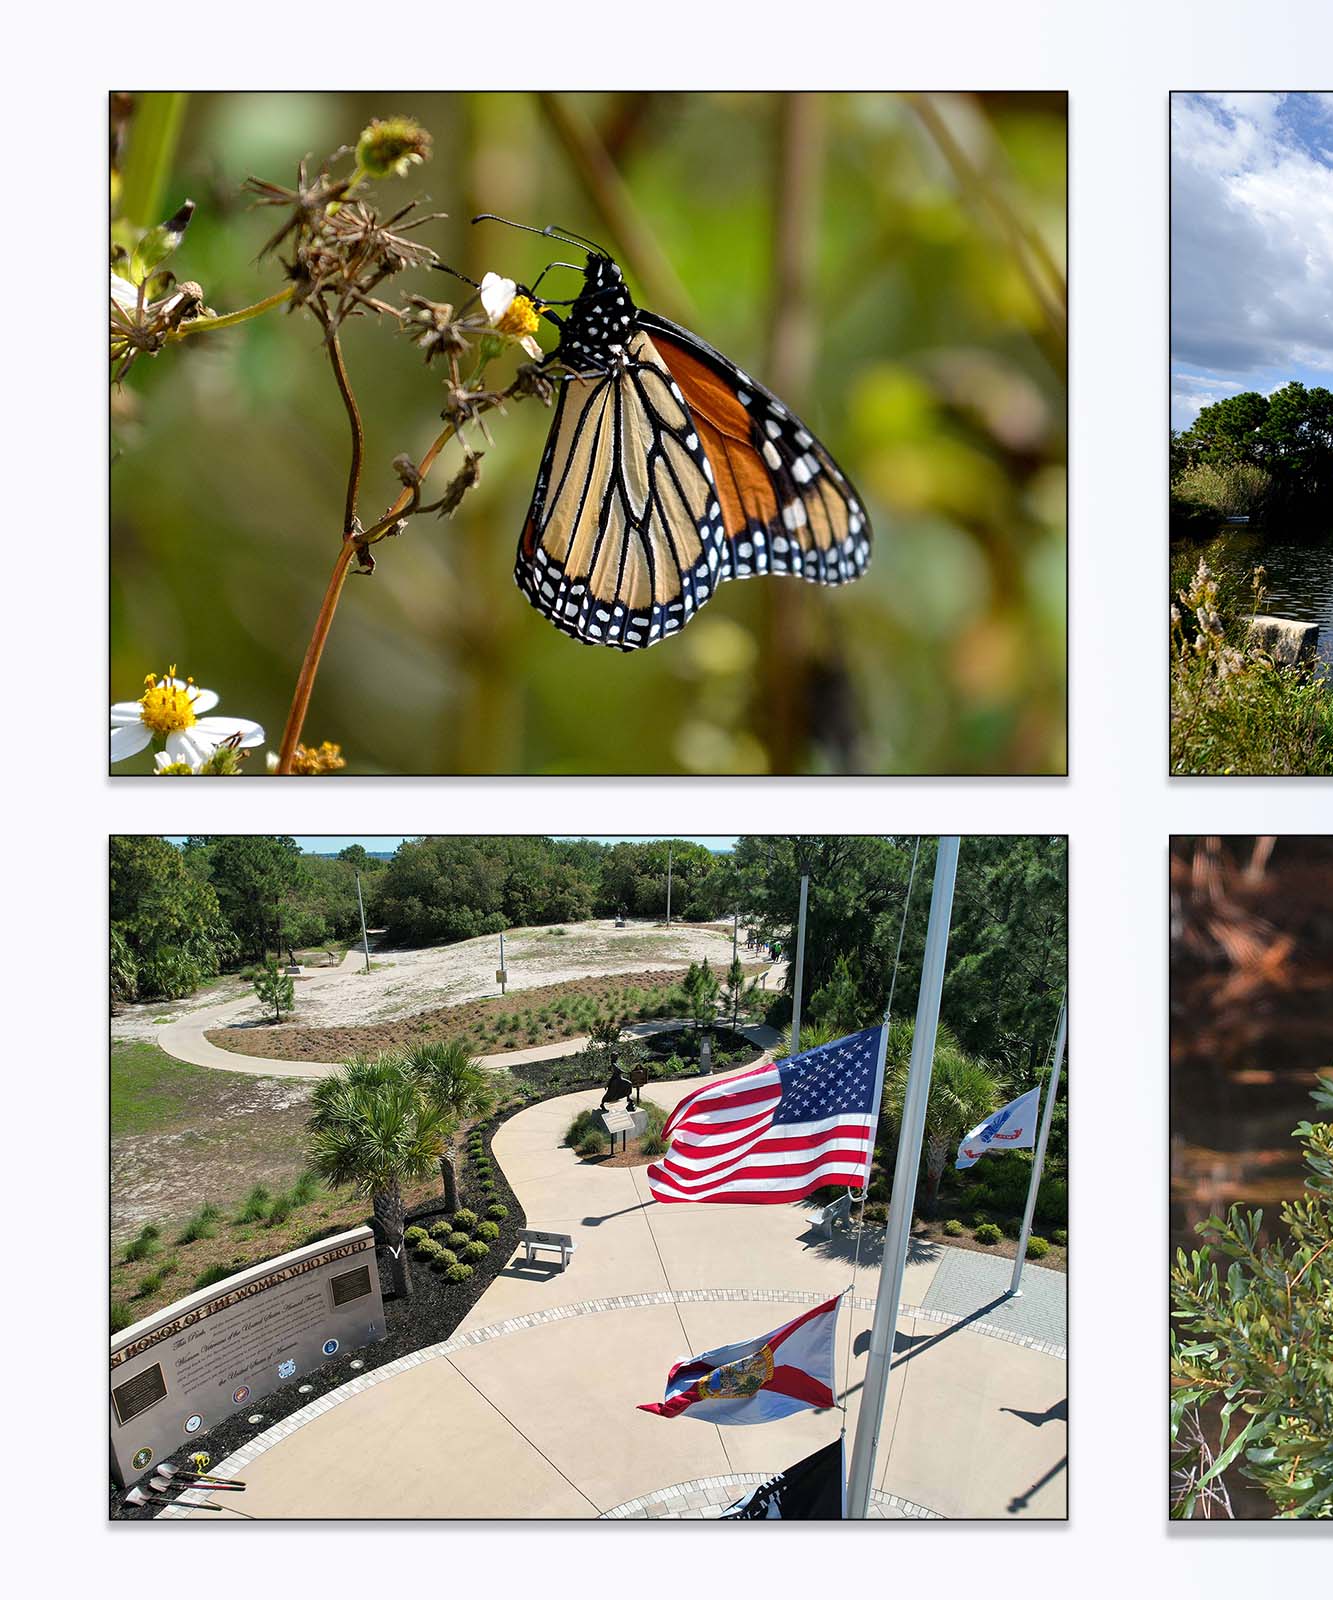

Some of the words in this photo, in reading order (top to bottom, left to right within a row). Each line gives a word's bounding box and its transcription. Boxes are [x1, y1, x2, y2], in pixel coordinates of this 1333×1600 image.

[126, 1320, 183, 1358] HONOR
[185, 1311, 206, 1326] OF
[206, 1294, 233, 1314] THE
[235, 1271, 286, 1299] WOMEN
[289, 1258, 321, 1277] WHO
[322, 1241, 367, 1264] SERVED
